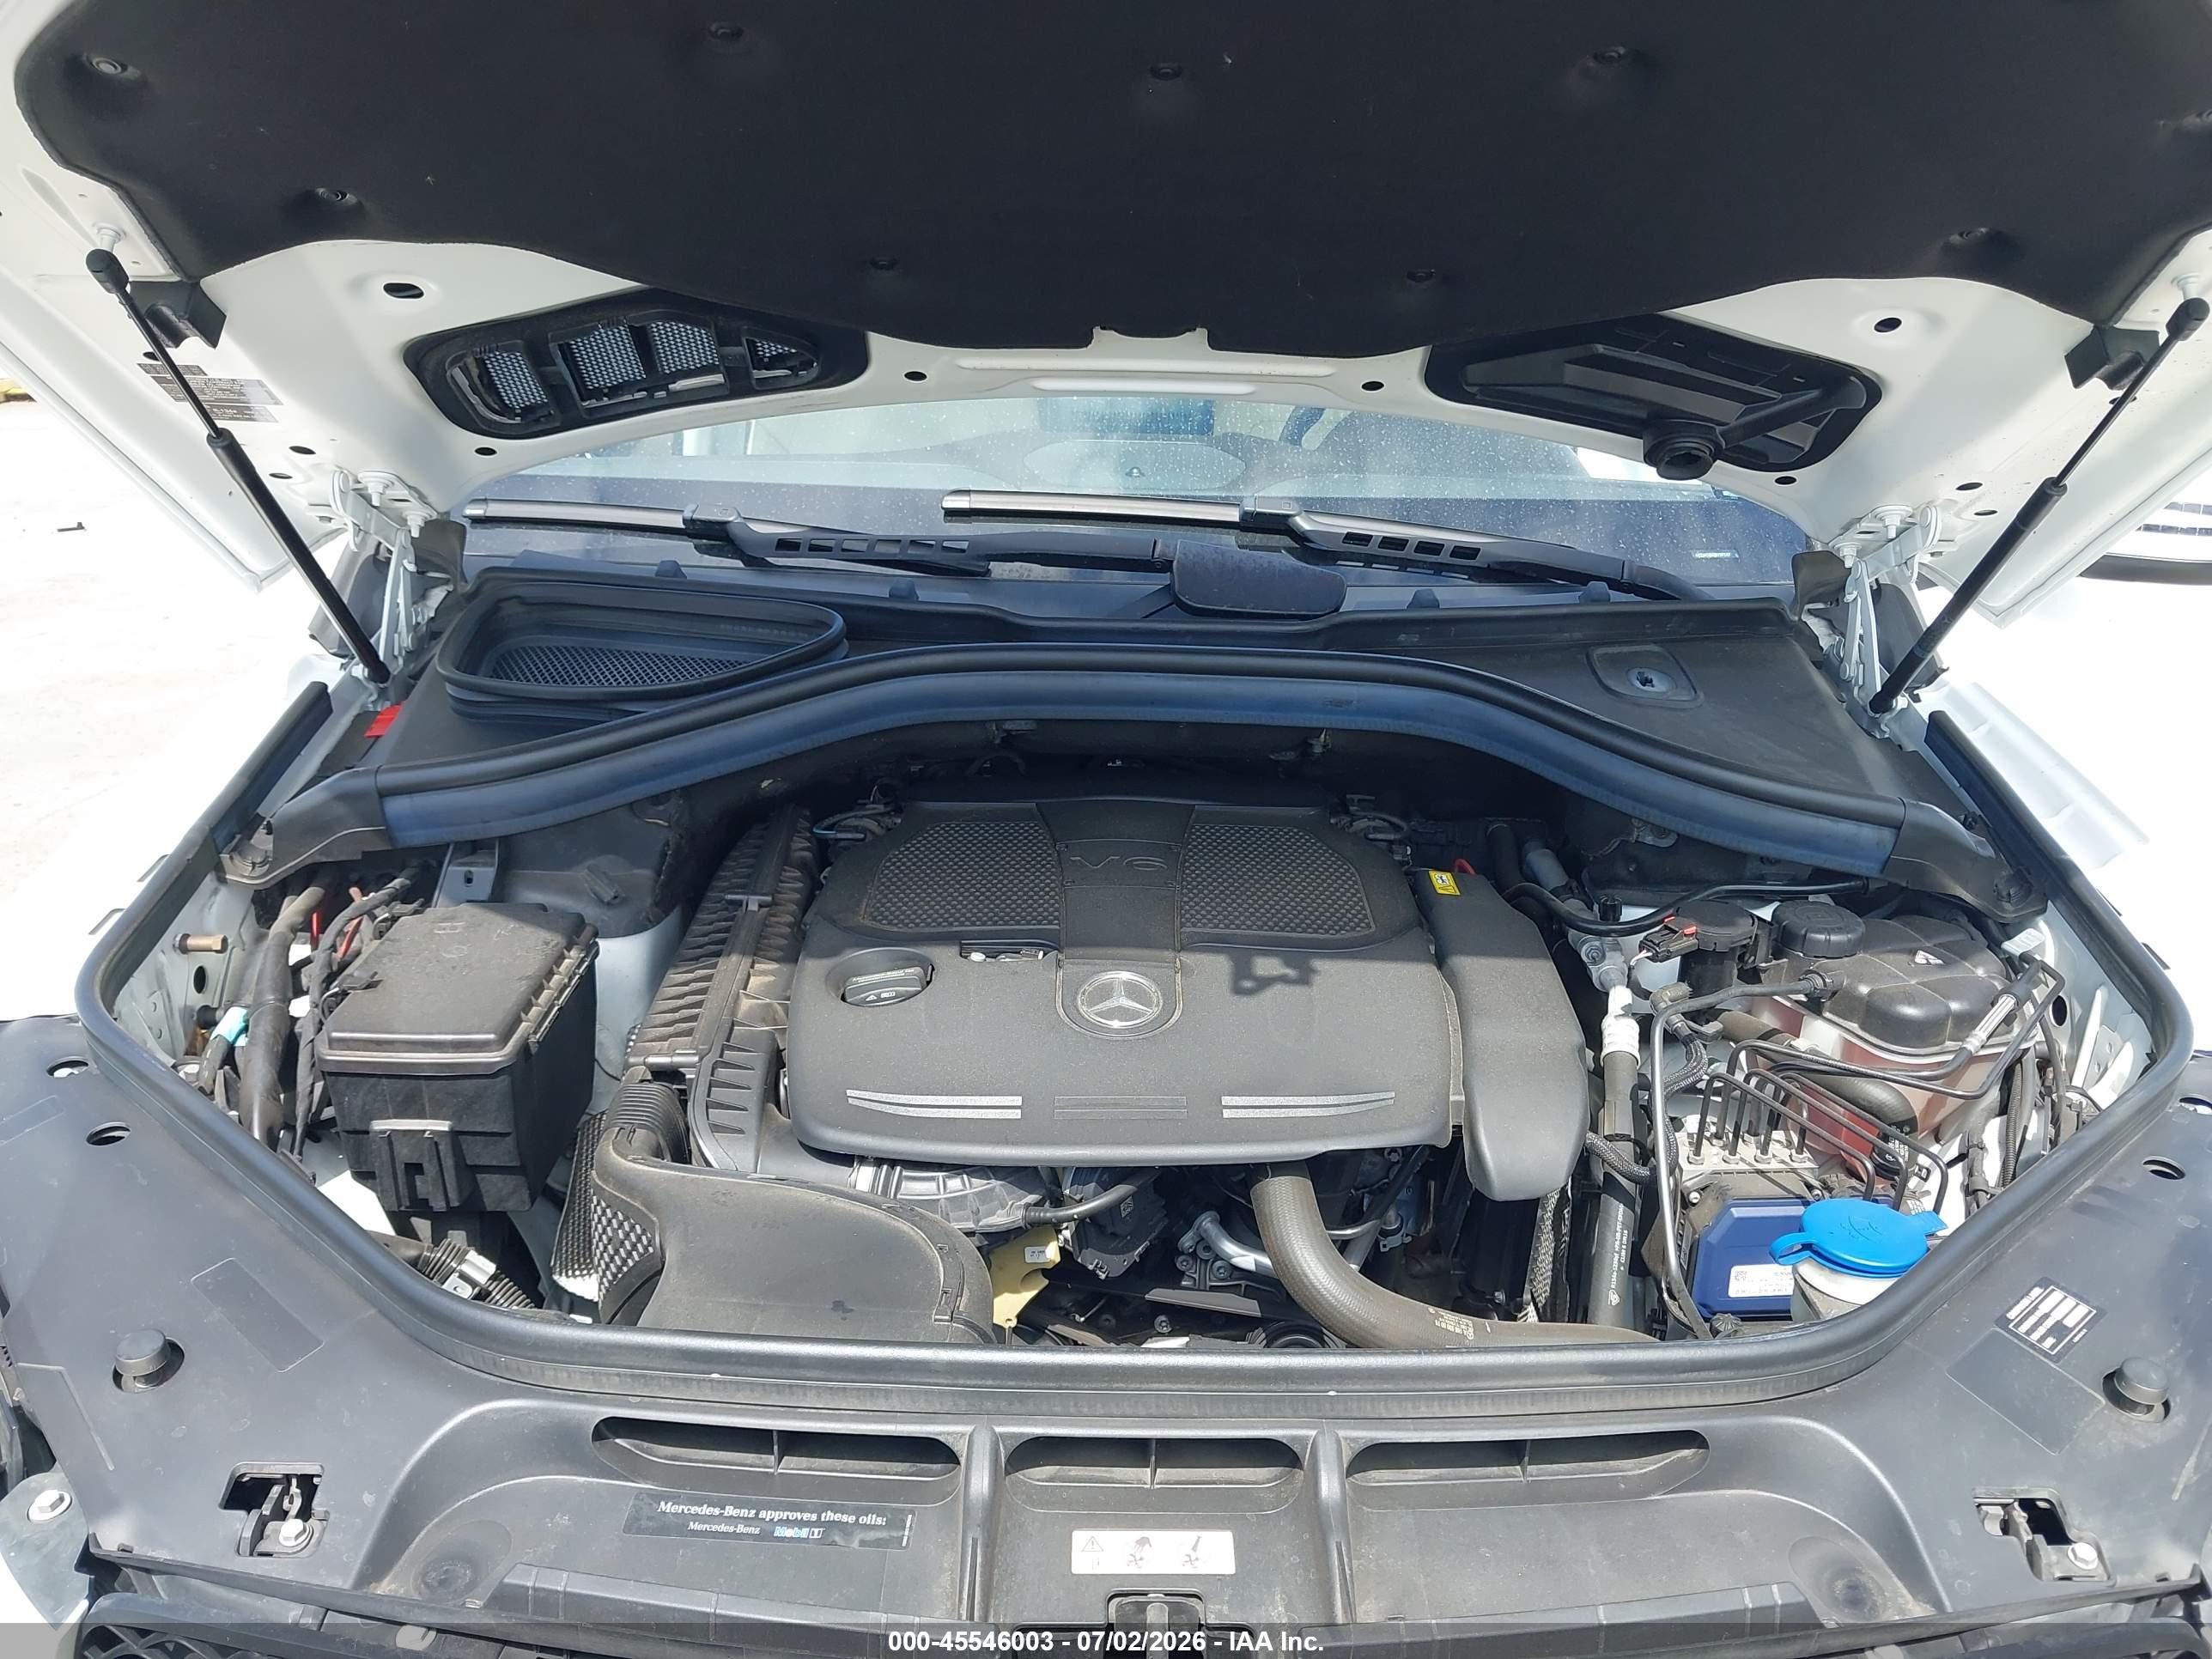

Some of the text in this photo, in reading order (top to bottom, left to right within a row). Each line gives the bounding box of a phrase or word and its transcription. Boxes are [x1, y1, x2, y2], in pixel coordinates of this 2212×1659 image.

[1069, 855, 1169, 872] V6
[657, 1501, 887, 1526] Mercedes-Benz approves these oils:
[687, 1521, 761, 1534] Mercedes-Benz
